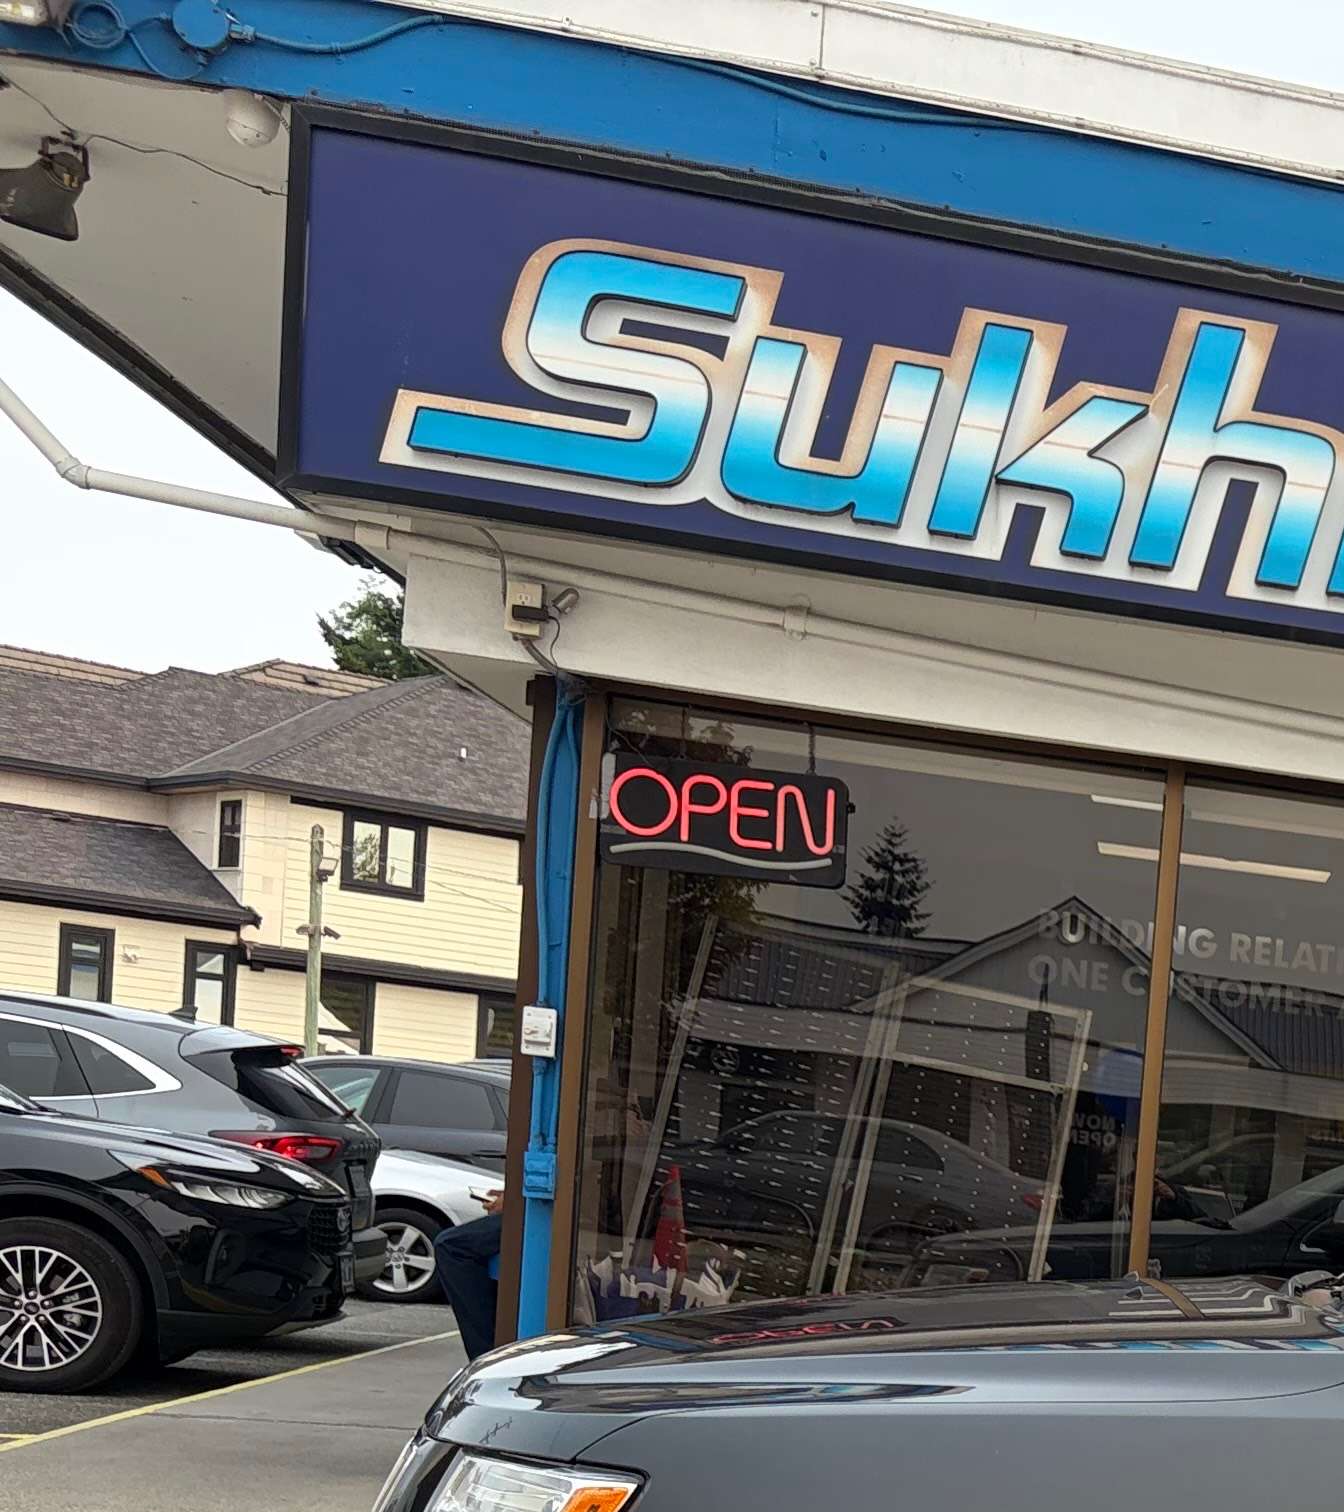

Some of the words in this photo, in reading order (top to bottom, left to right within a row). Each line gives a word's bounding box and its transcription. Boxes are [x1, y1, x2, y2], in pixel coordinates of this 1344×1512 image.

[609, 767, 836, 856] OPEN
[1027, 953, 1109, 993] ONE
[1121, 965, 1324, 1017] CSTOMER
